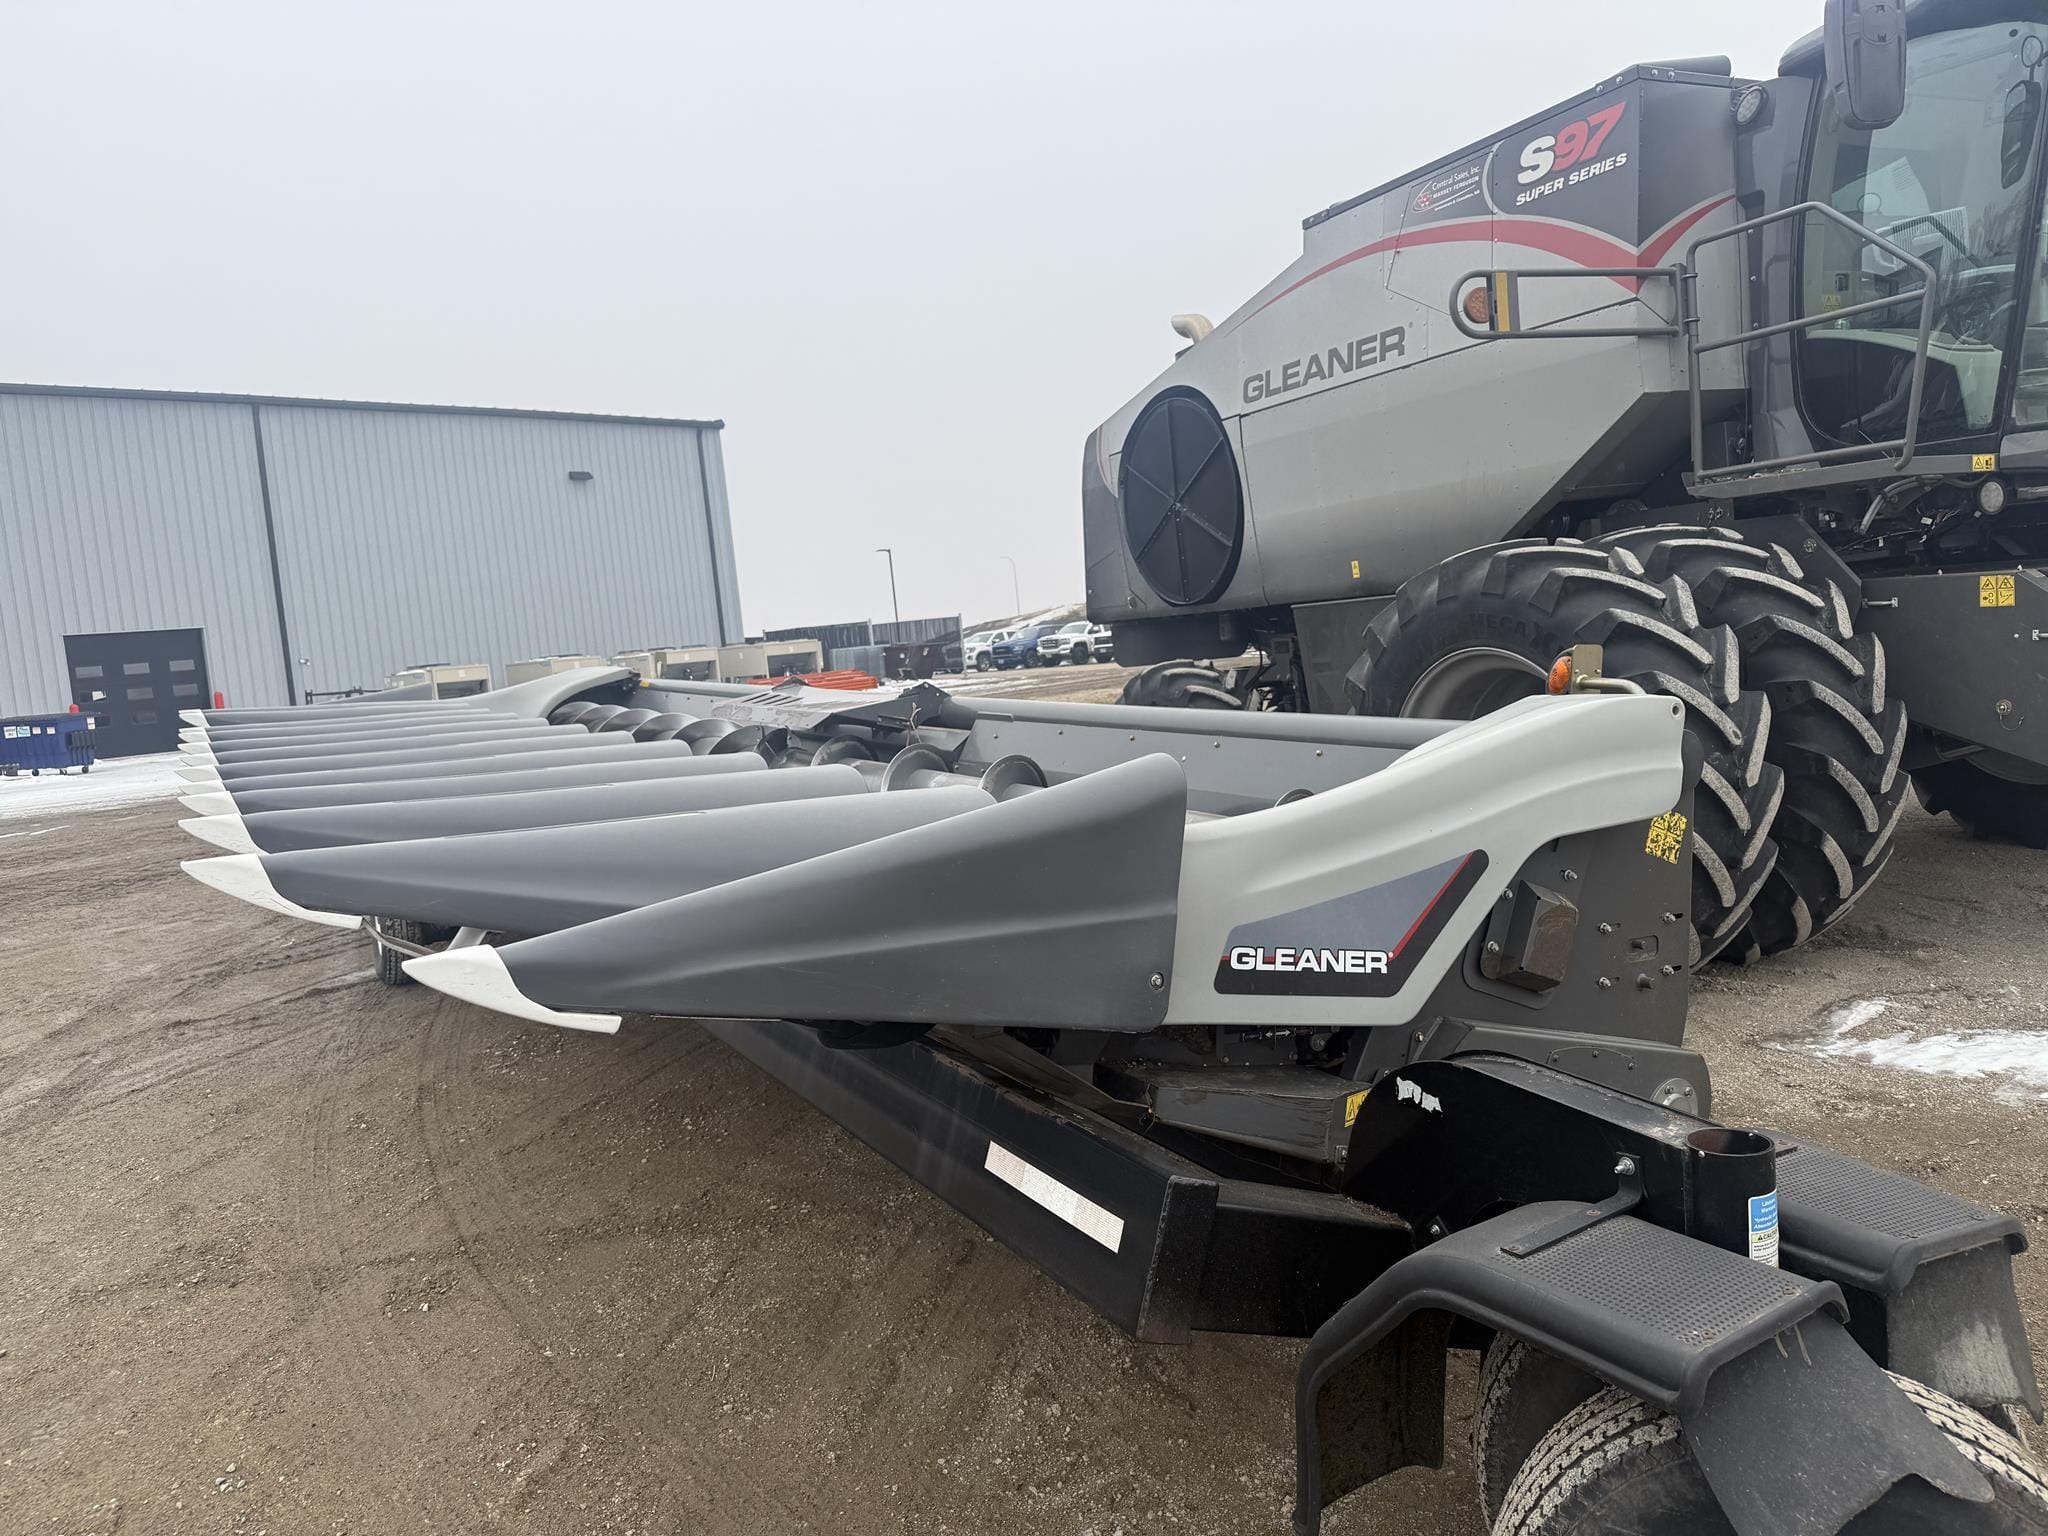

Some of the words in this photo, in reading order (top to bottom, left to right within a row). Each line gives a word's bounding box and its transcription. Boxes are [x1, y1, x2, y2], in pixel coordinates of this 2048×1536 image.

[1518, 101, 1627, 184] S97
[1432, 175, 1454, 191] Central
[1516, 178, 1564, 206] SUPER
[1568, 152, 1628, 185] SERIES
[1243, 325, 1406, 404] GLEANER
[1230, 946, 1388, 974] GLEANER
